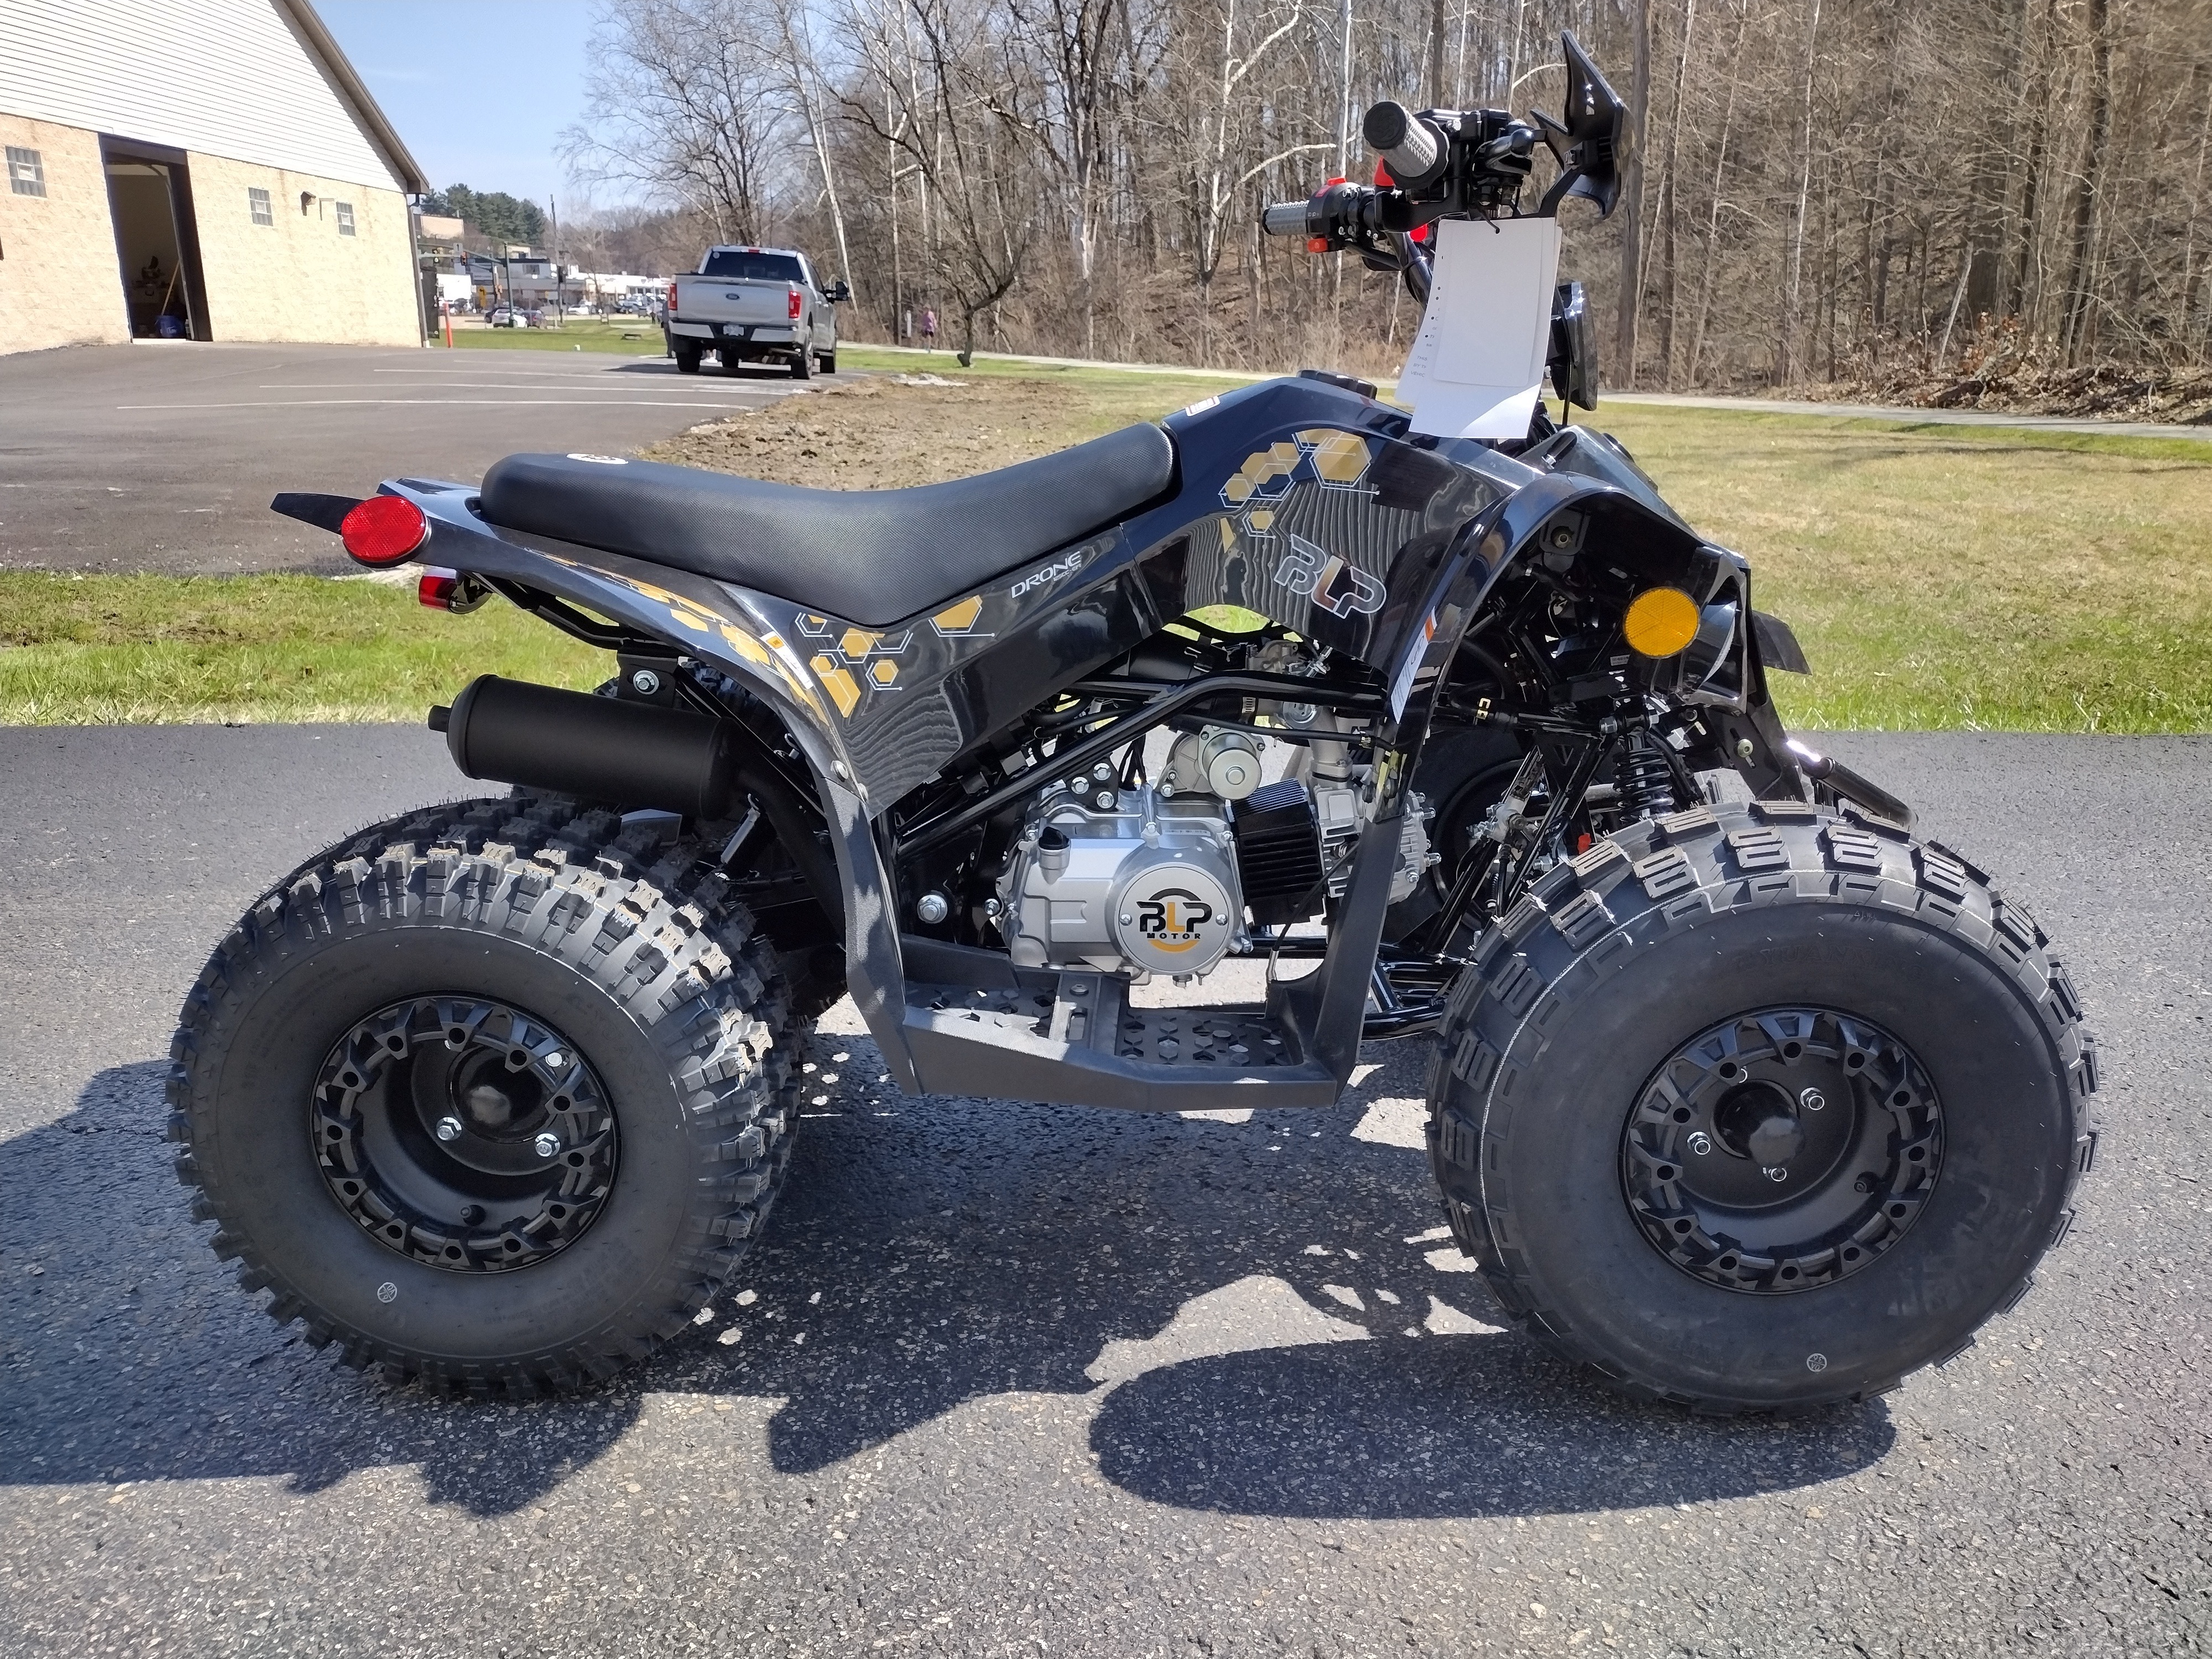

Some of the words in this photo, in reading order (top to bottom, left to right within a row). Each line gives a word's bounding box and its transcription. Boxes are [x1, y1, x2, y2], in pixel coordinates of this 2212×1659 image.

[1011, 551, 1081, 598] DRONE
[1274, 533, 1387, 619] BLP
[1136, 901, 1212, 932] BLP
